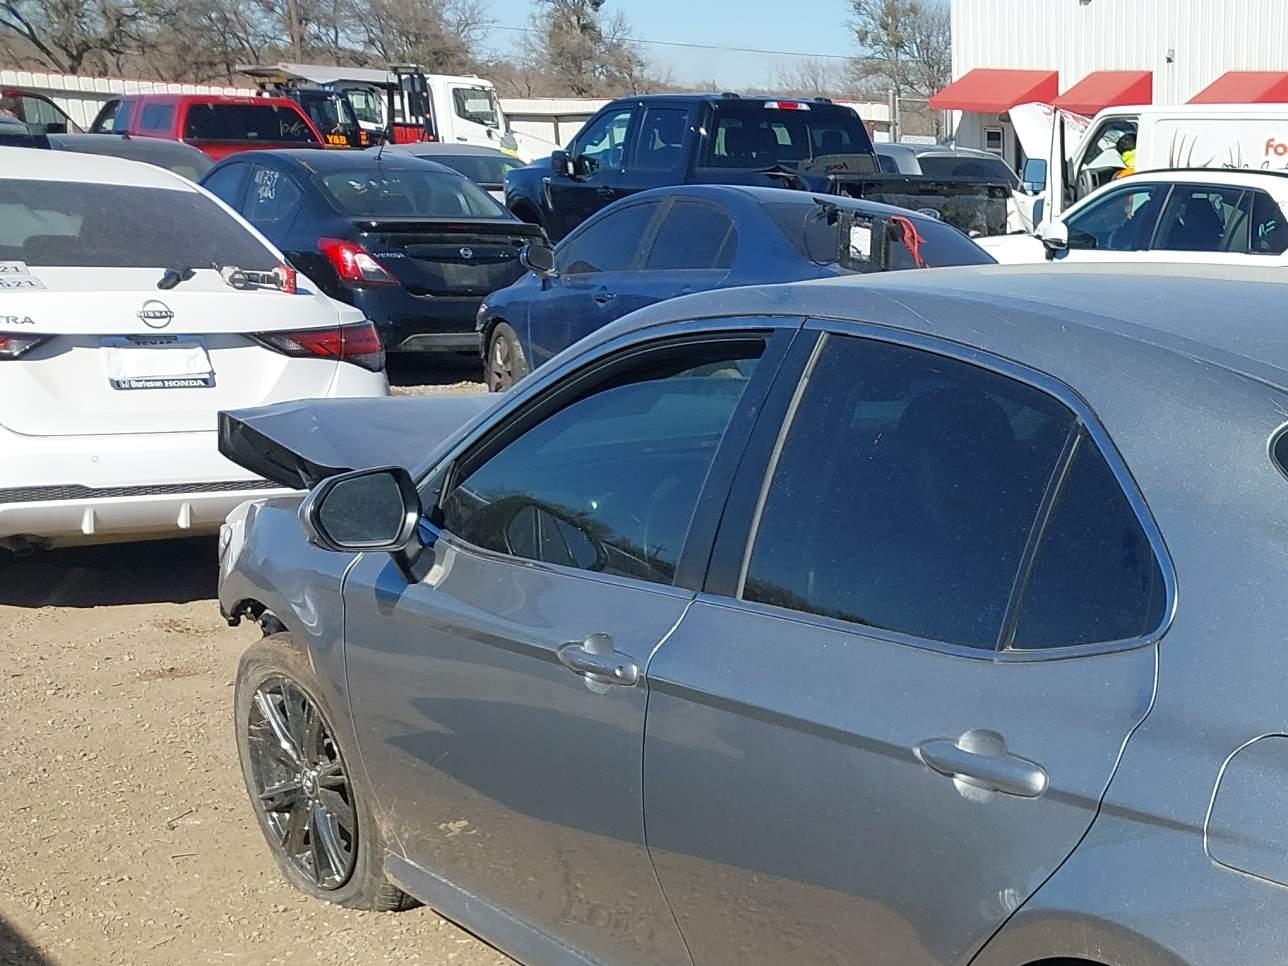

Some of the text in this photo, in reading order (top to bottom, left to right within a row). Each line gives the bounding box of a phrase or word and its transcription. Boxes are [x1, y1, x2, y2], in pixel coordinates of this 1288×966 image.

[327, 134, 348, 144] Y&B
[137, 309, 176, 320] NISSAN
[164, 378, 206, 388] HONDA
